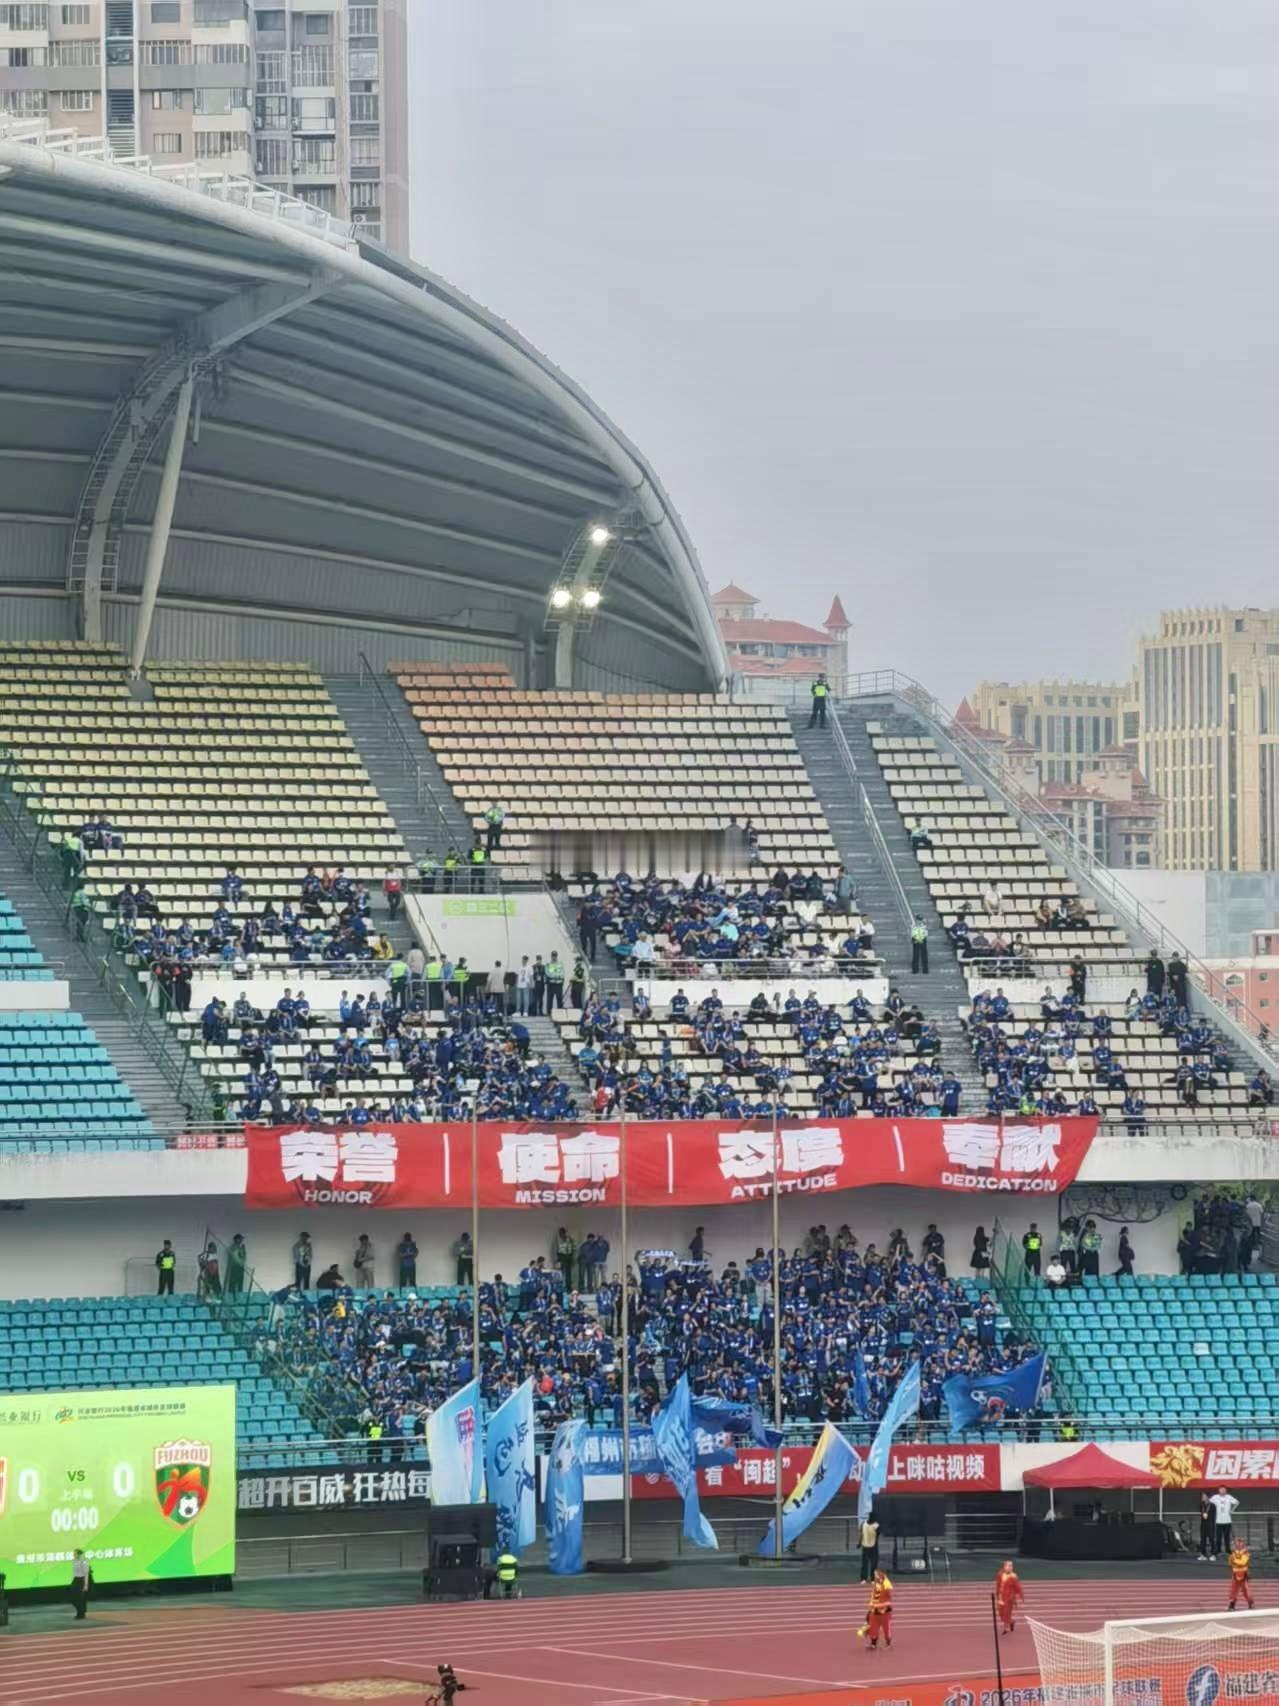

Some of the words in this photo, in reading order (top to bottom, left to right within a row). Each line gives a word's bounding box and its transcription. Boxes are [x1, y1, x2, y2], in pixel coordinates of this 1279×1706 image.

[280, 1131, 398, 1182] 荣誉
[498, 1131, 620, 1183] 使命
[718, 1127, 844, 1179] 态度
[943, 1124, 1062, 1173] 奉献
[731, 1173, 837, 1199] ATTITUDE
[941, 1172, 1058, 1192] DEDICATION
[304, 1189, 373, 1205] HONOR
[515, 1189, 607, 1204] MISSION
[157, 1447, 209, 1465] FUZHOU
[888, 1455, 984, 1482] 上咪咕视频
[1205, 1449, 1279, 1480] 困累
[18, 1468, 39, 1503] 0
[67, 1470, 86, 1482] VS
[113, 1462, 135, 1498] 0
[51, 1507, 99, 1532] 00:00
